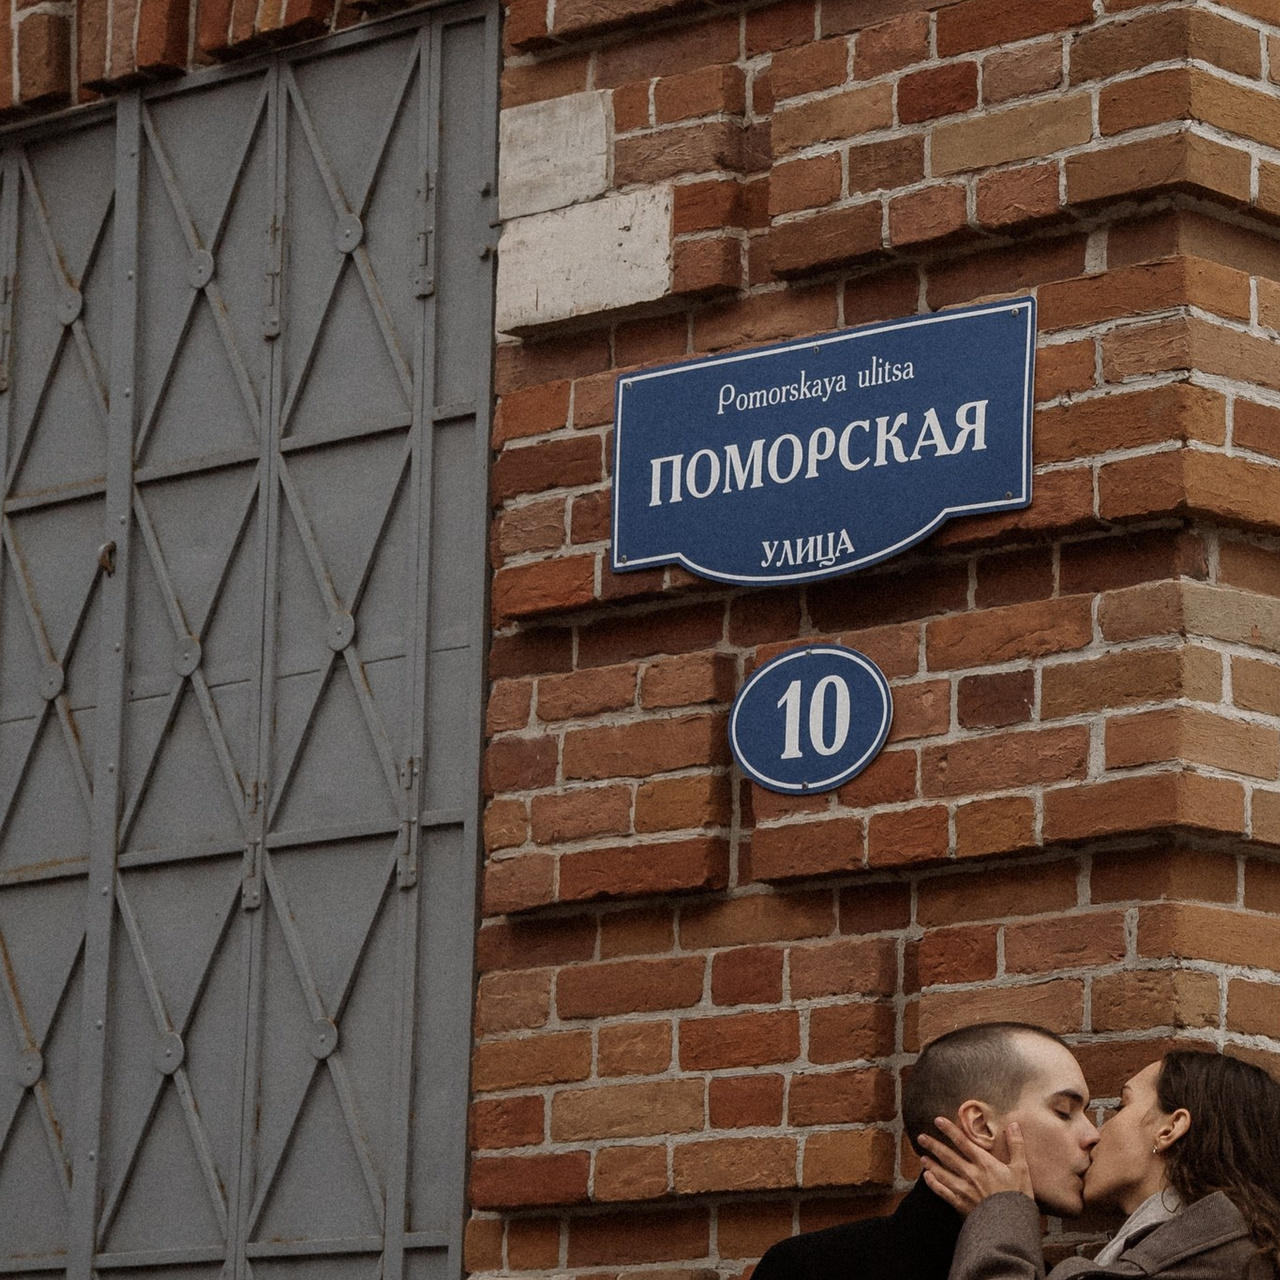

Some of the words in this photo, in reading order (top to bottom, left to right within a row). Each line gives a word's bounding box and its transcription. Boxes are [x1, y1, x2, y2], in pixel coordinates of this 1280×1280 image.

[716, 370, 847, 415] Pomorskaya
[857, 356, 915, 387] ulitsa
[648, 399, 989, 507] ПОМОРСКАЯ
[761, 528, 855, 568] УЛИЦА
[777, 674, 851, 760] 10
